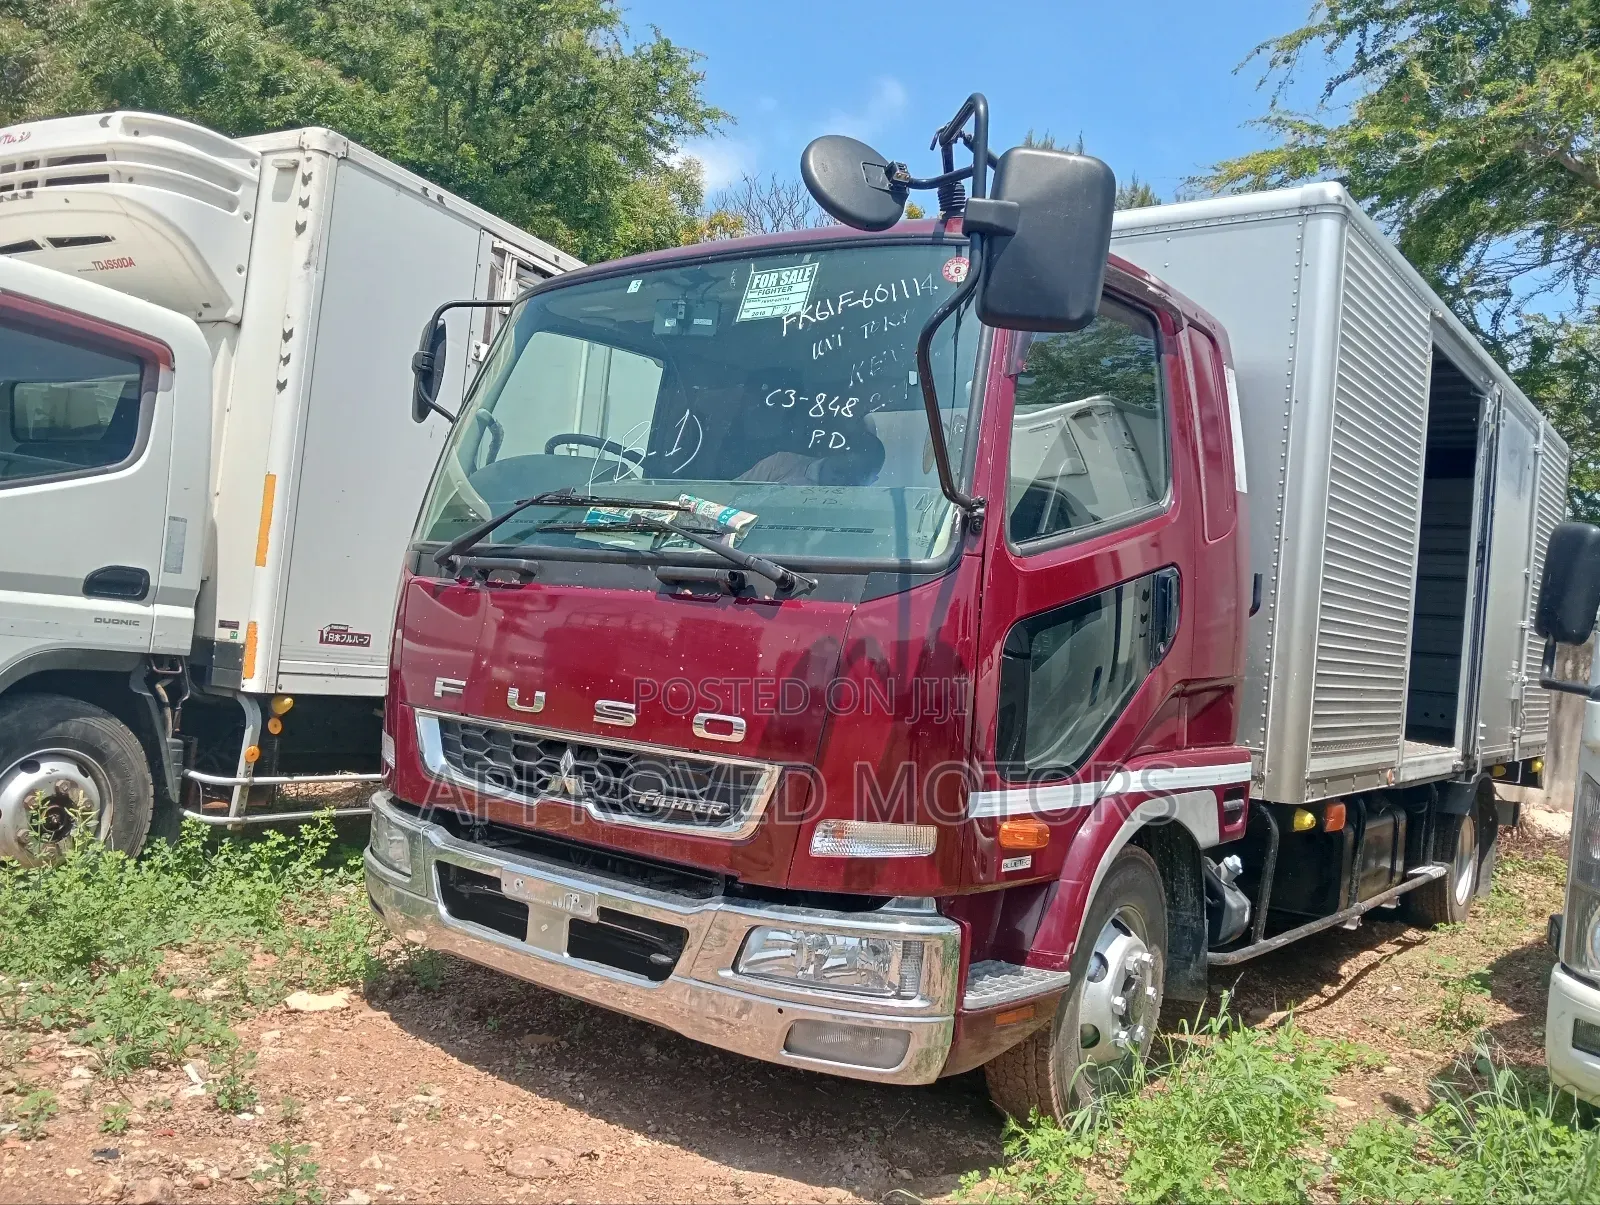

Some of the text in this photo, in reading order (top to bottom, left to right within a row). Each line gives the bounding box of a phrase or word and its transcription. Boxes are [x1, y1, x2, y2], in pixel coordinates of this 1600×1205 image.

[91, 256, 137, 271] TDJS50DA
[954, 266, 961, 274] 6
[753, 267, 813, 289] FOR SALE
[757, 285, 794, 296] FIGHTER
[765, 389, 860, 418] C3-848
[93, 617, 140, 627] DUONIC
[328, 633, 370, 645] 日本フルハーフ
[433, 677, 747, 743] FUSO
